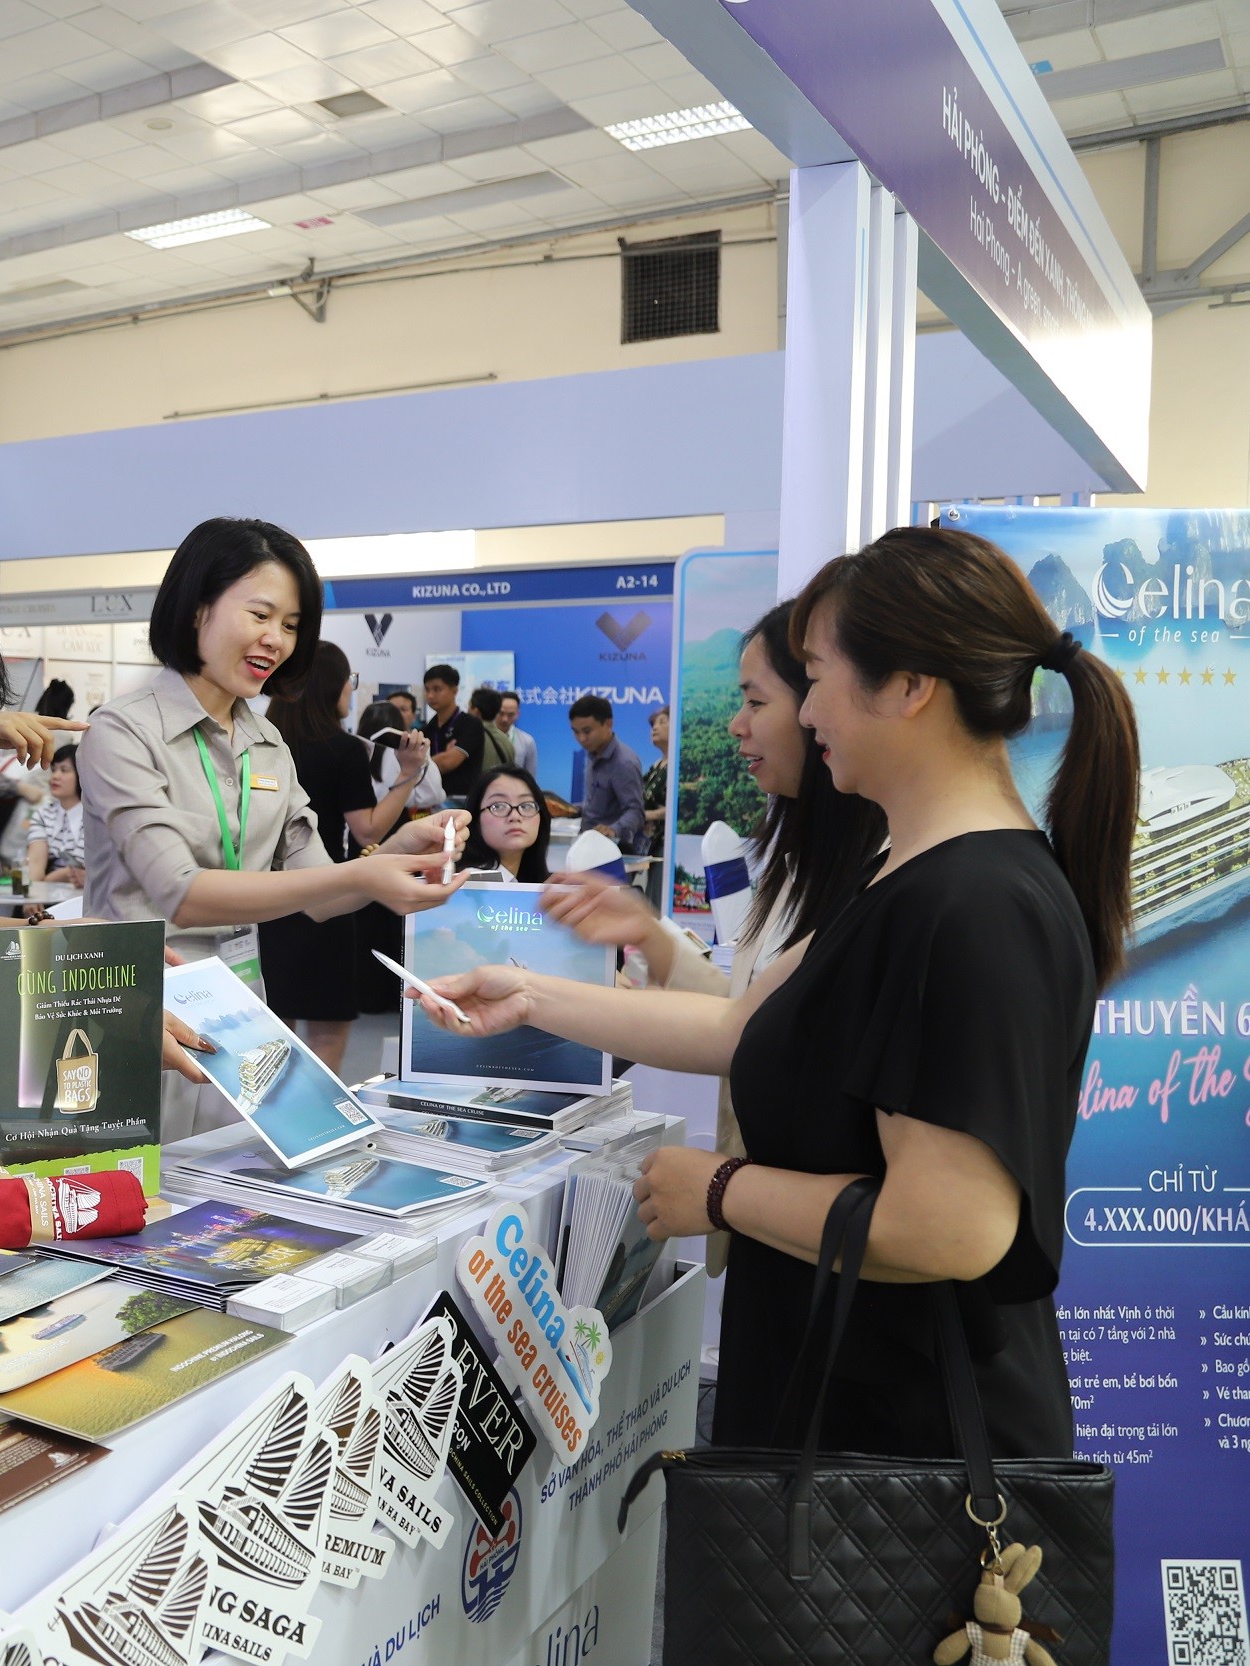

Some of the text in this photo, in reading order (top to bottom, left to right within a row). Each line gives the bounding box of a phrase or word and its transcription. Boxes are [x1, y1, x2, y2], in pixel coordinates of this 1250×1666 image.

[942, 86, 963, 152] HẢI
[964, 118, 1000, 204] PHÒNG
[1007, 184, 1028, 247] ĐIỂM
[970, 194, 1023, 295] Hai Phong A
[412, 583, 460, 598] KIZUNA
[616, 575, 658, 590] A2-14
[90, 593, 134, 613] LUX
[1128, 625, 1220, 647] of the sea
[366, 648, 391, 657] KIZUNA
[599, 652, 646, 661] KIZUNA
[476, 905, 543, 926] Celina
[501, 924, 513, 932] the
[55, 951, 104, 962] DU LỊCH XANH
[17, 964, 137, 996] CÙNG INDOCHINE
[173, 988, 213, 1004] Celina
[1092, 983, 1226, 1036] THUYỀN
[63, 1066, 92, 1082] SAY NO
[63, 1080, 92, 1090] TO PLASTIC
[1147, 1049, 1181, 1124] of
[64, 1088, 91, 1104] BAGS
[420, 1101, 437, 1109] CELINA
[467, 1107, 485, 1116] CRUISE
[5, 1132, 18, 1142] Cơ
[20, 1130, 35, 1141] Hội
[37, 1128, 59, 1139] Nhận
[1148, 1163, 1218, 1193] CHỈ TỪ
[39, 1200, 49, 1227] SAILS
[496, 1214, 565, 1350] Celina
[1074, 1306, 1090, 1320] lớn
[1093, 1304, 1114, 1320] nhất
[1118, 1306, 1141, 1322] Vịnh
[1155, 1306, 1175, 1320] thời
[1213, 1304, 1233, 1320] Cầu
[1068, 1326, 1176, 1343] tại có 7 tầng với 2 nhà
[468, 1249, 582, 1452] of the sea cruises
[1070, 1348, 1093, 1364] biệt.
[1215, 1359, 1235, 1374] Bao
[1084, 1372, 1178, 1390] trẻ em, bể bơi bốn
[1216, 1386, 1231, 1400] Vé
[540, 1472, 557, 1504] SỞ
[580, 1439, 604, 1471] HÓA,
[606, 1409, 626, 1448] THỂ
[625, 1398, 649, 1430] THAO
[662, 1377, 673, 1399] DU
[674, 1359, 691, 1389] LỊCH
[1076, 1422, 1178, 1441] hiện đại trọng tải lớn
[1218, 1435, 1239, 1449] và 3
[569, 1409, 668, 1512] THÀNH PHỐ HẢI PHÒNG
[1093, 1449, 1111, 1464] tích
[464, 1470, 498, 1526] SAILS COLLECTION
[397, 1485, 442, 1533] SAILS
[386, 1507, 416, 1536] HA BAY
[324, 1533, 387, 1566] REMIUM
[333, 1565, 354, 1580] BAY
[239, 1600, 307, 1646] SAGA
[385, 1626, 406, 1663] DU
[408, 1594, 441, 1641] LỊCH
[546, 1605, 600, 1666] lina
[231, 1634, 273, 1662] SAILS
